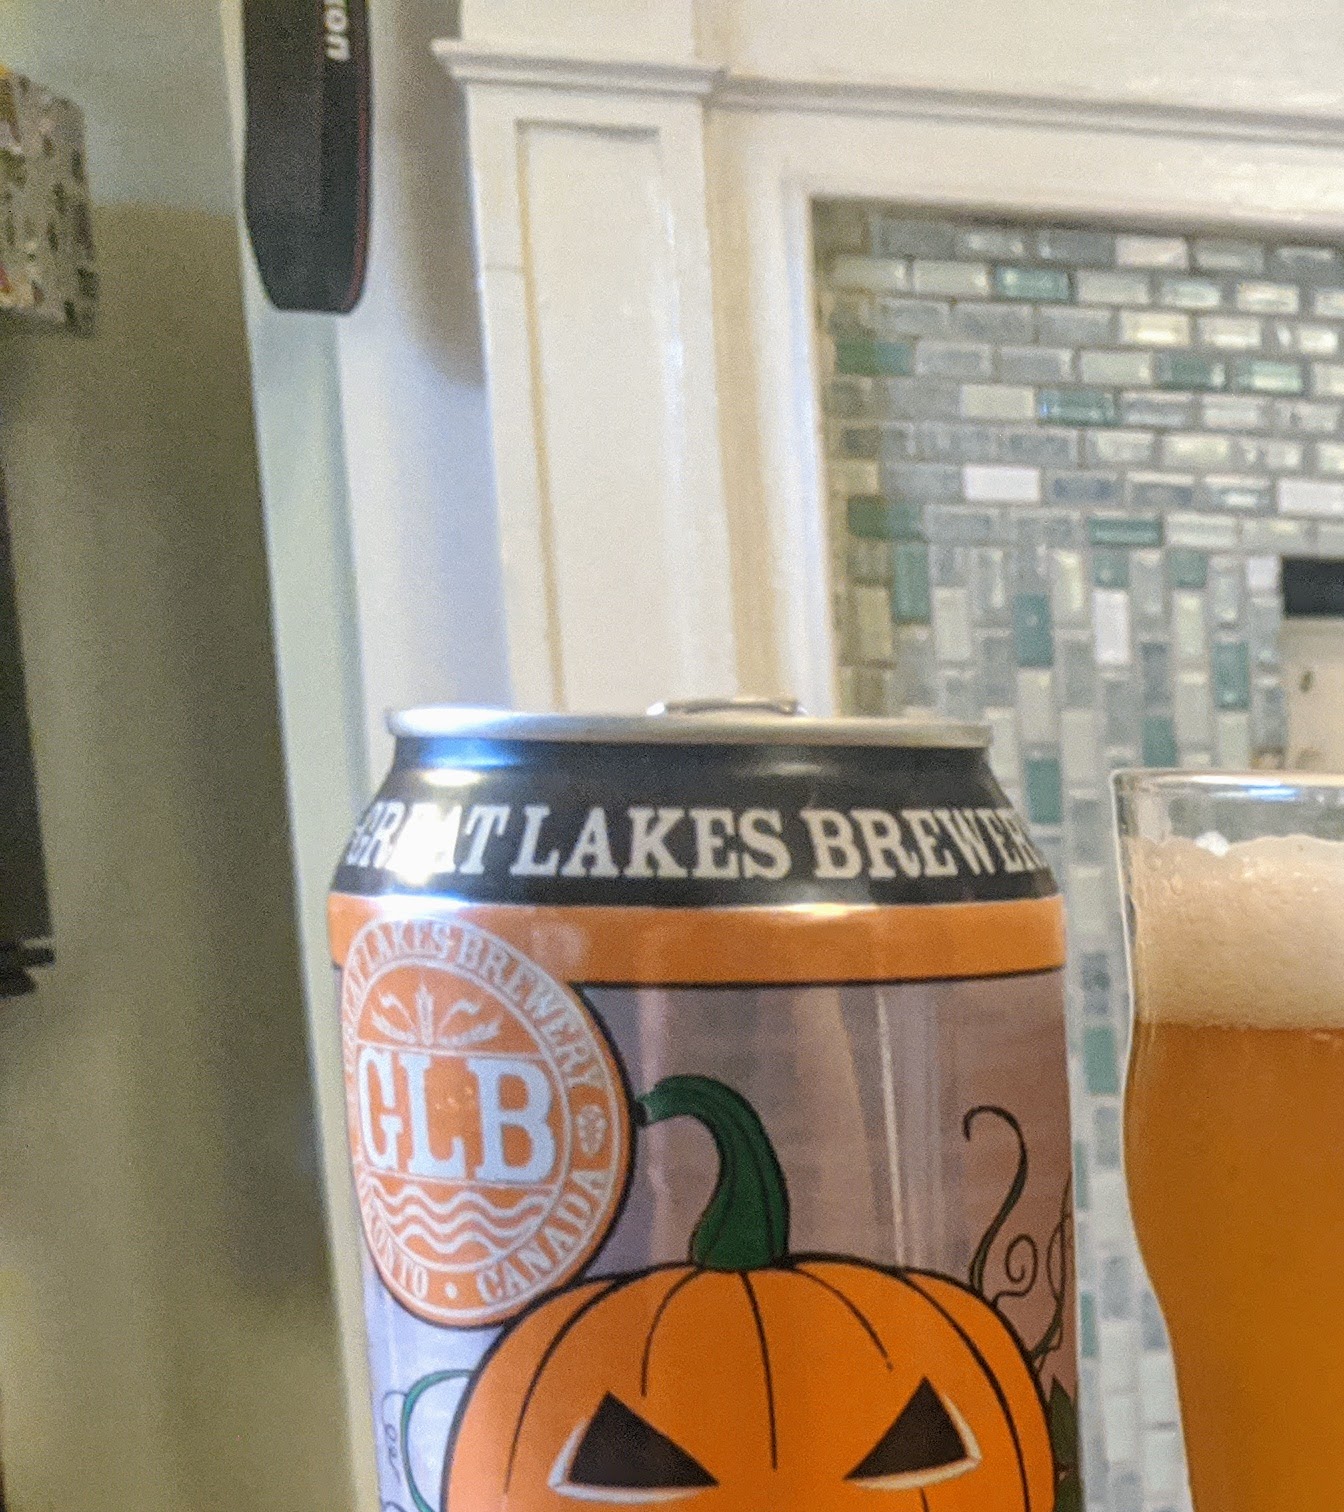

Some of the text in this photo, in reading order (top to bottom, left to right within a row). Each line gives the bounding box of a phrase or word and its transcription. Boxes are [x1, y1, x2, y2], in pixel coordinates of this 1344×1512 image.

[346, 800, 510, 876] GRAT
[509, 804, 793, 880] LAKES
[459, 923, 599, 1088] BREWERY
[357, 1045, 558, 1185] GLB
[475, 1169, 607, 1306] CANADA
